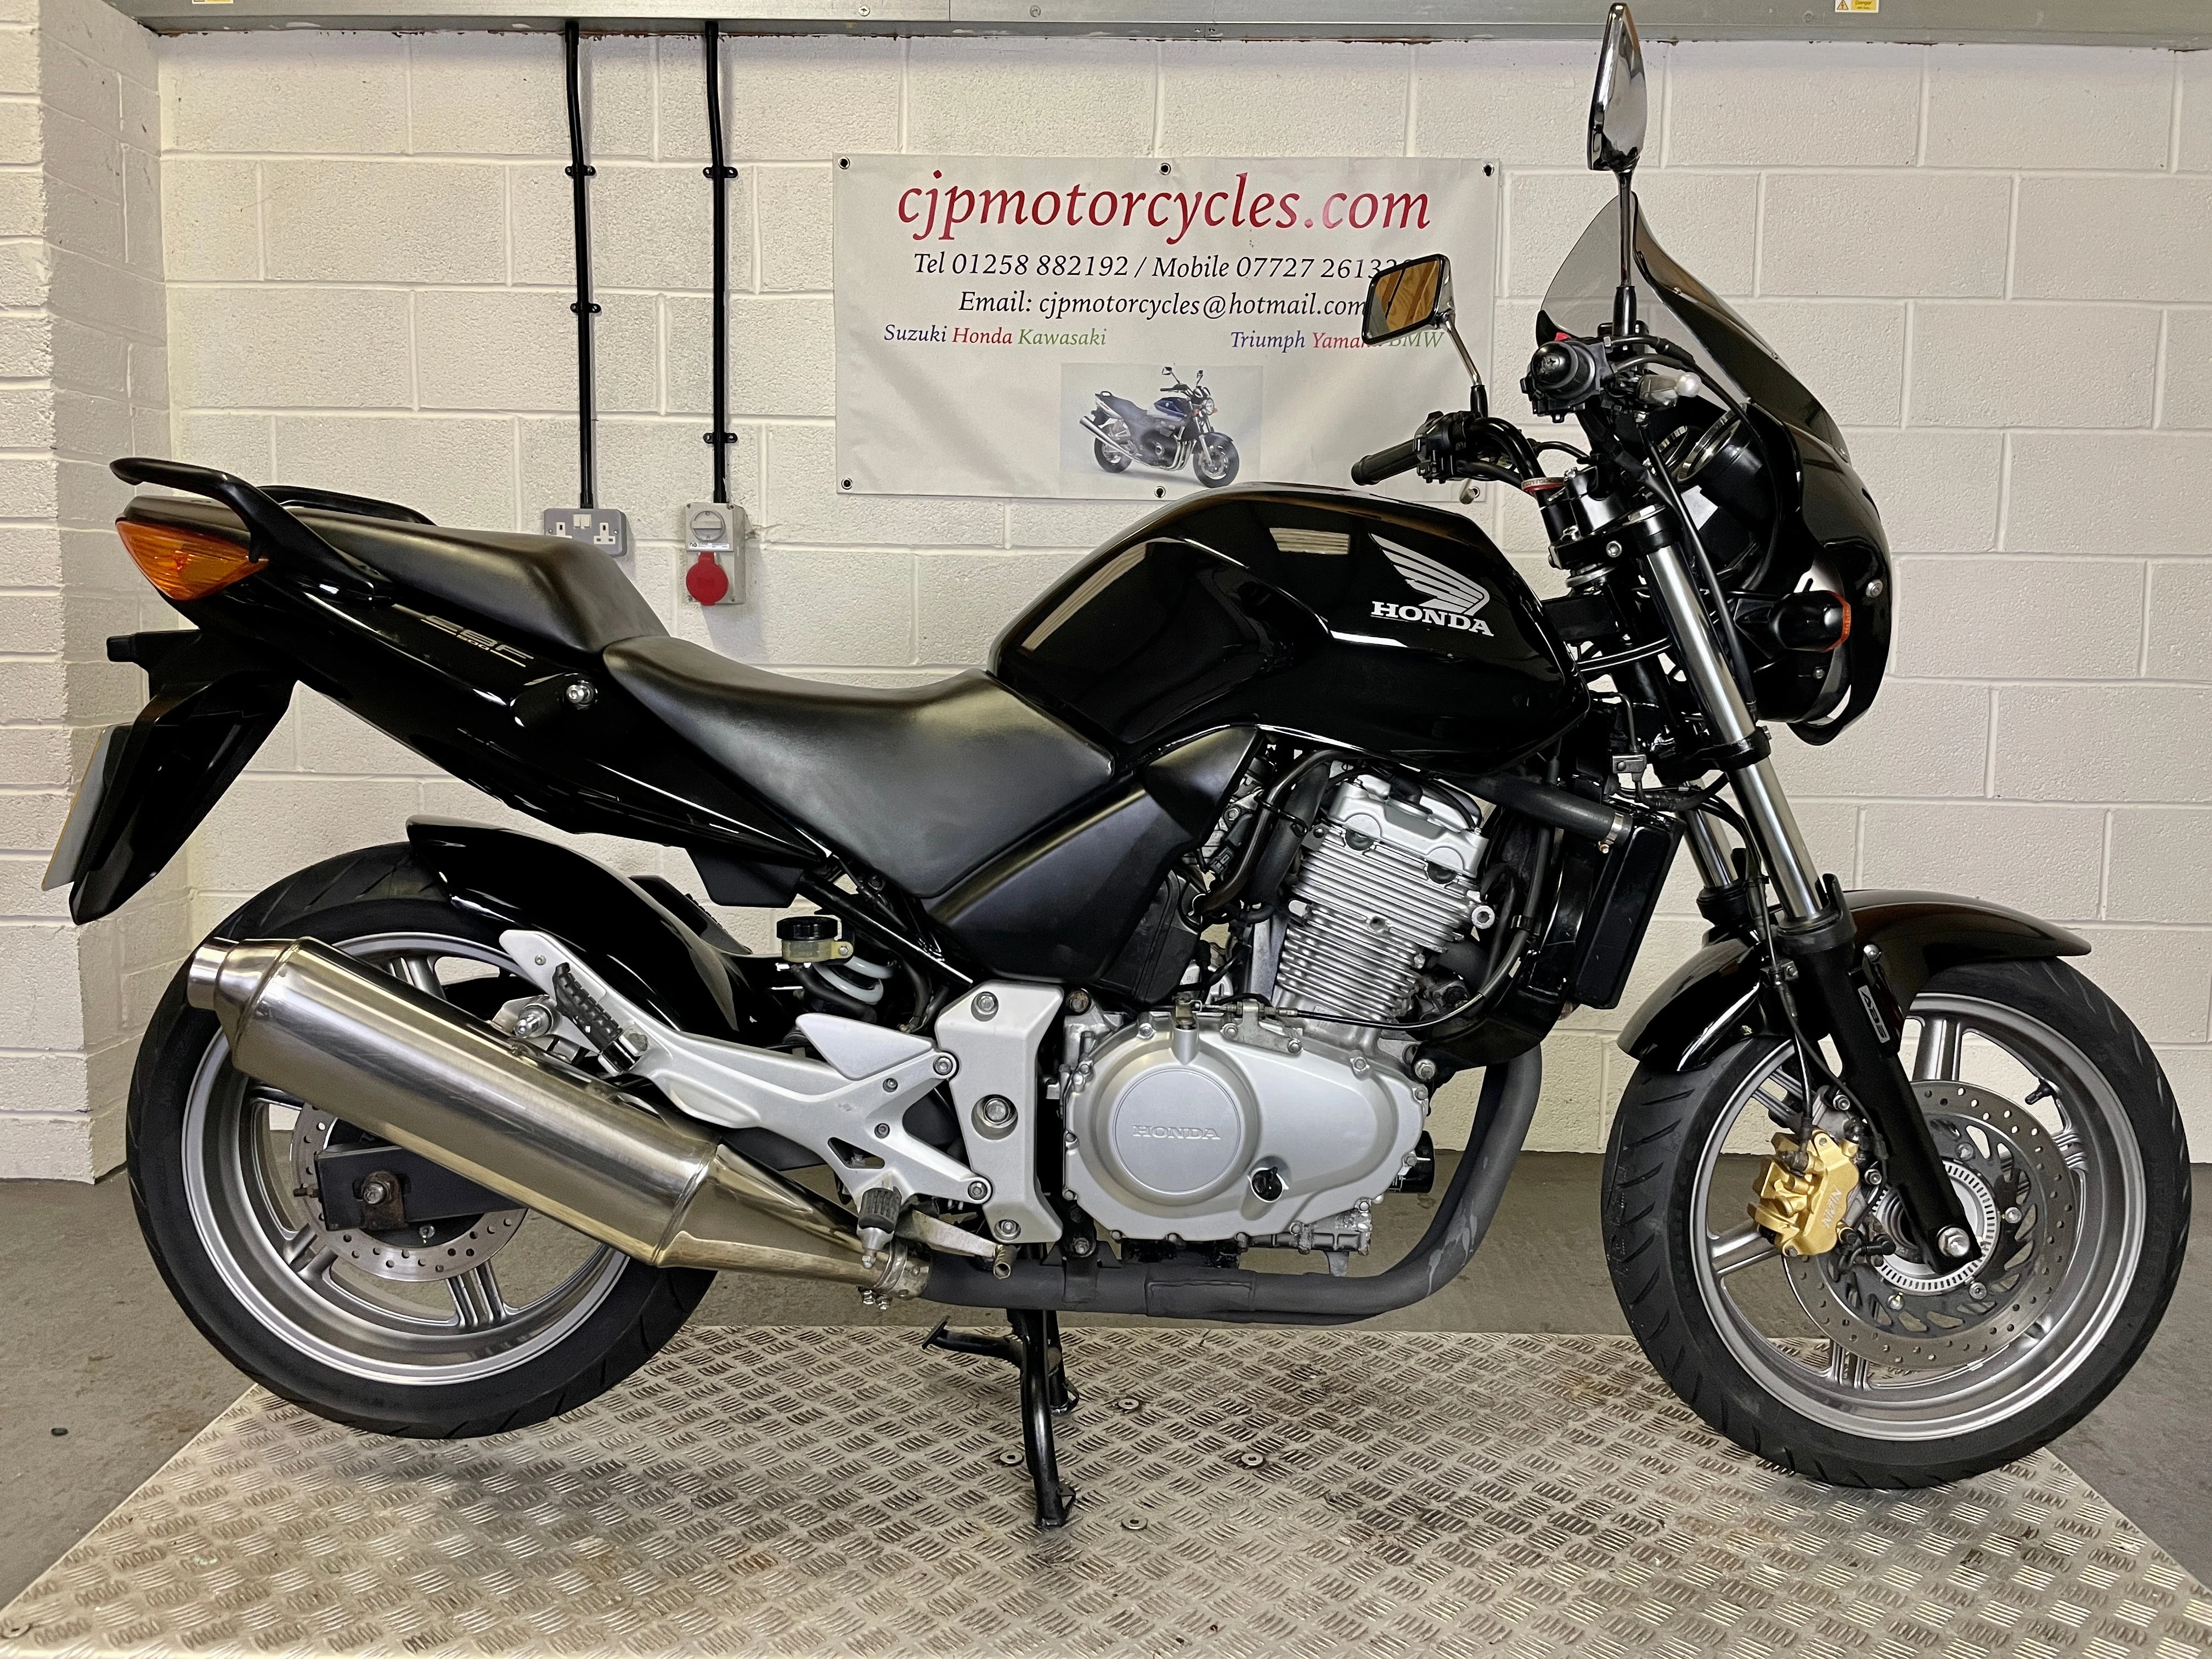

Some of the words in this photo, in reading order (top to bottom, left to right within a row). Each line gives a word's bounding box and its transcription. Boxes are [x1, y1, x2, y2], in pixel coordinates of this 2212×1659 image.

[898, 170, 1430, 245] cjpmotorcycles.com
[915, 251, 945, 274] Tel
[952, 253, 1029, 275] 01258
[1036, 255, 1128, 276] 882192
[1134, 256, 1147, 278] /
[1153, 255, 1229, 278] Mobile
[1236, 257, 1314, 278] 07727
[1321, 258, 1412, 279] 2613
[958, 290, 1032, 312] Email:
[1039, 291, 1365, 319] cjpmotorcycles@hotmail.com
[884, 324, 947, 342] Suzuki
[952, 327, 1013, 345] Honda
[1018, 328, 1107, 345] Kawasaki
[1231, 330, 1306, 353] Triumph
[1312, 332, 1381, 348] Yama
[1371, 601, 1494, 636] HONDA
[1860, 991, 1888, 1039] ABS
[1132, 1125, 1221, 1140] HONDA
